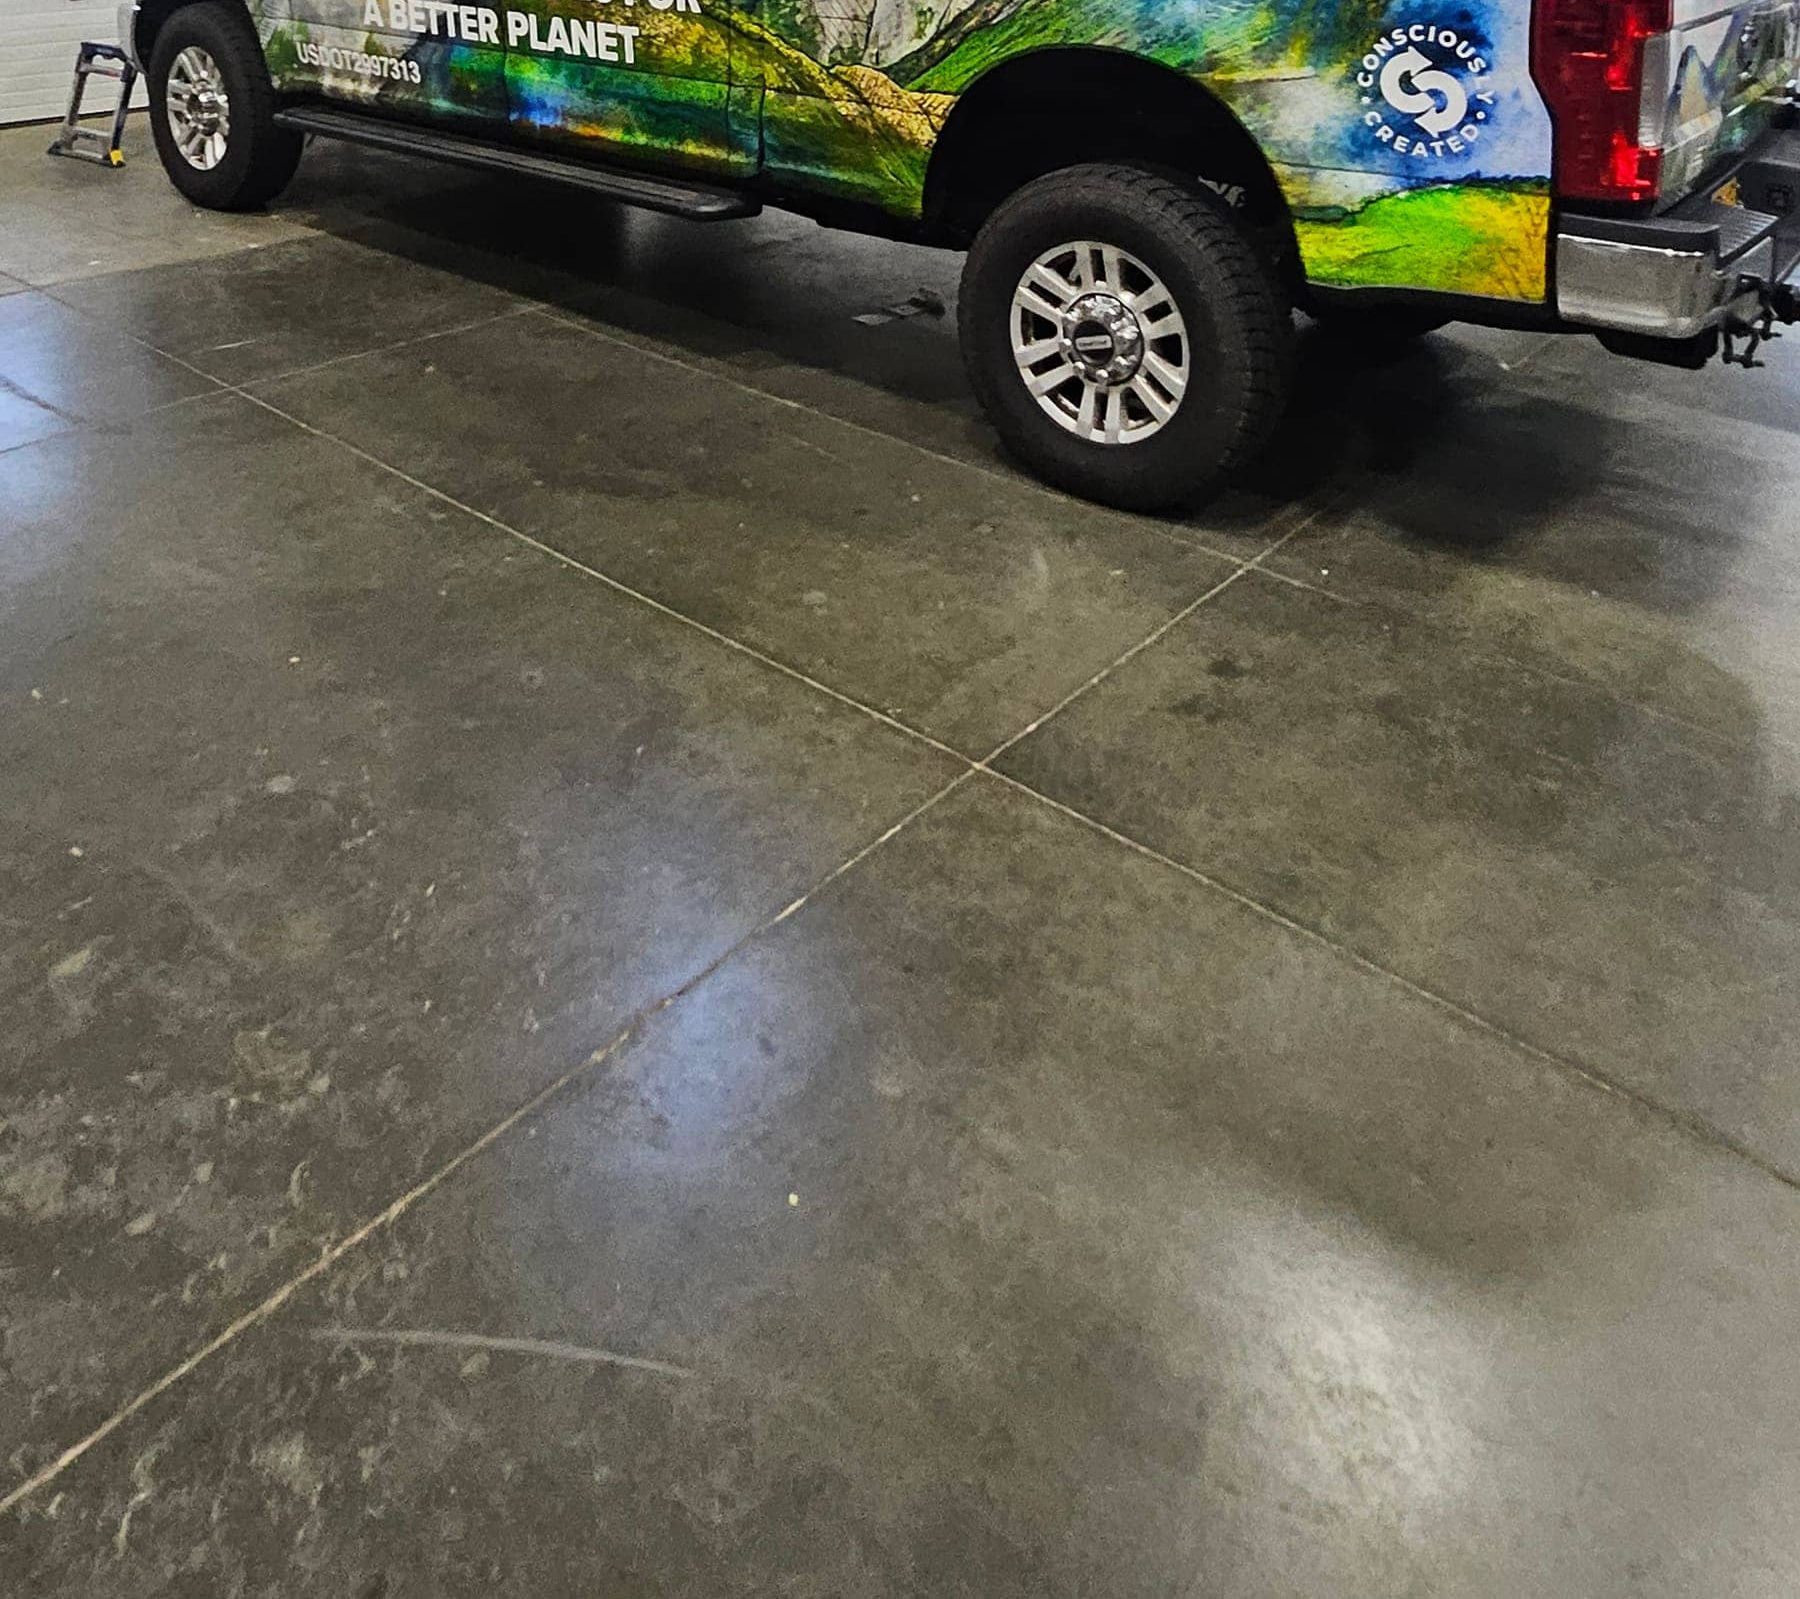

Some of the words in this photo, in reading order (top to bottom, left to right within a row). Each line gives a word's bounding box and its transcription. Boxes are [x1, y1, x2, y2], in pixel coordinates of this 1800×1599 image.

[507, 11, 640, 64] PLANET
[1357, 24, 1496, 105] CONSCIOUSLY
[1364, 111, 1479, 158] CREATED
